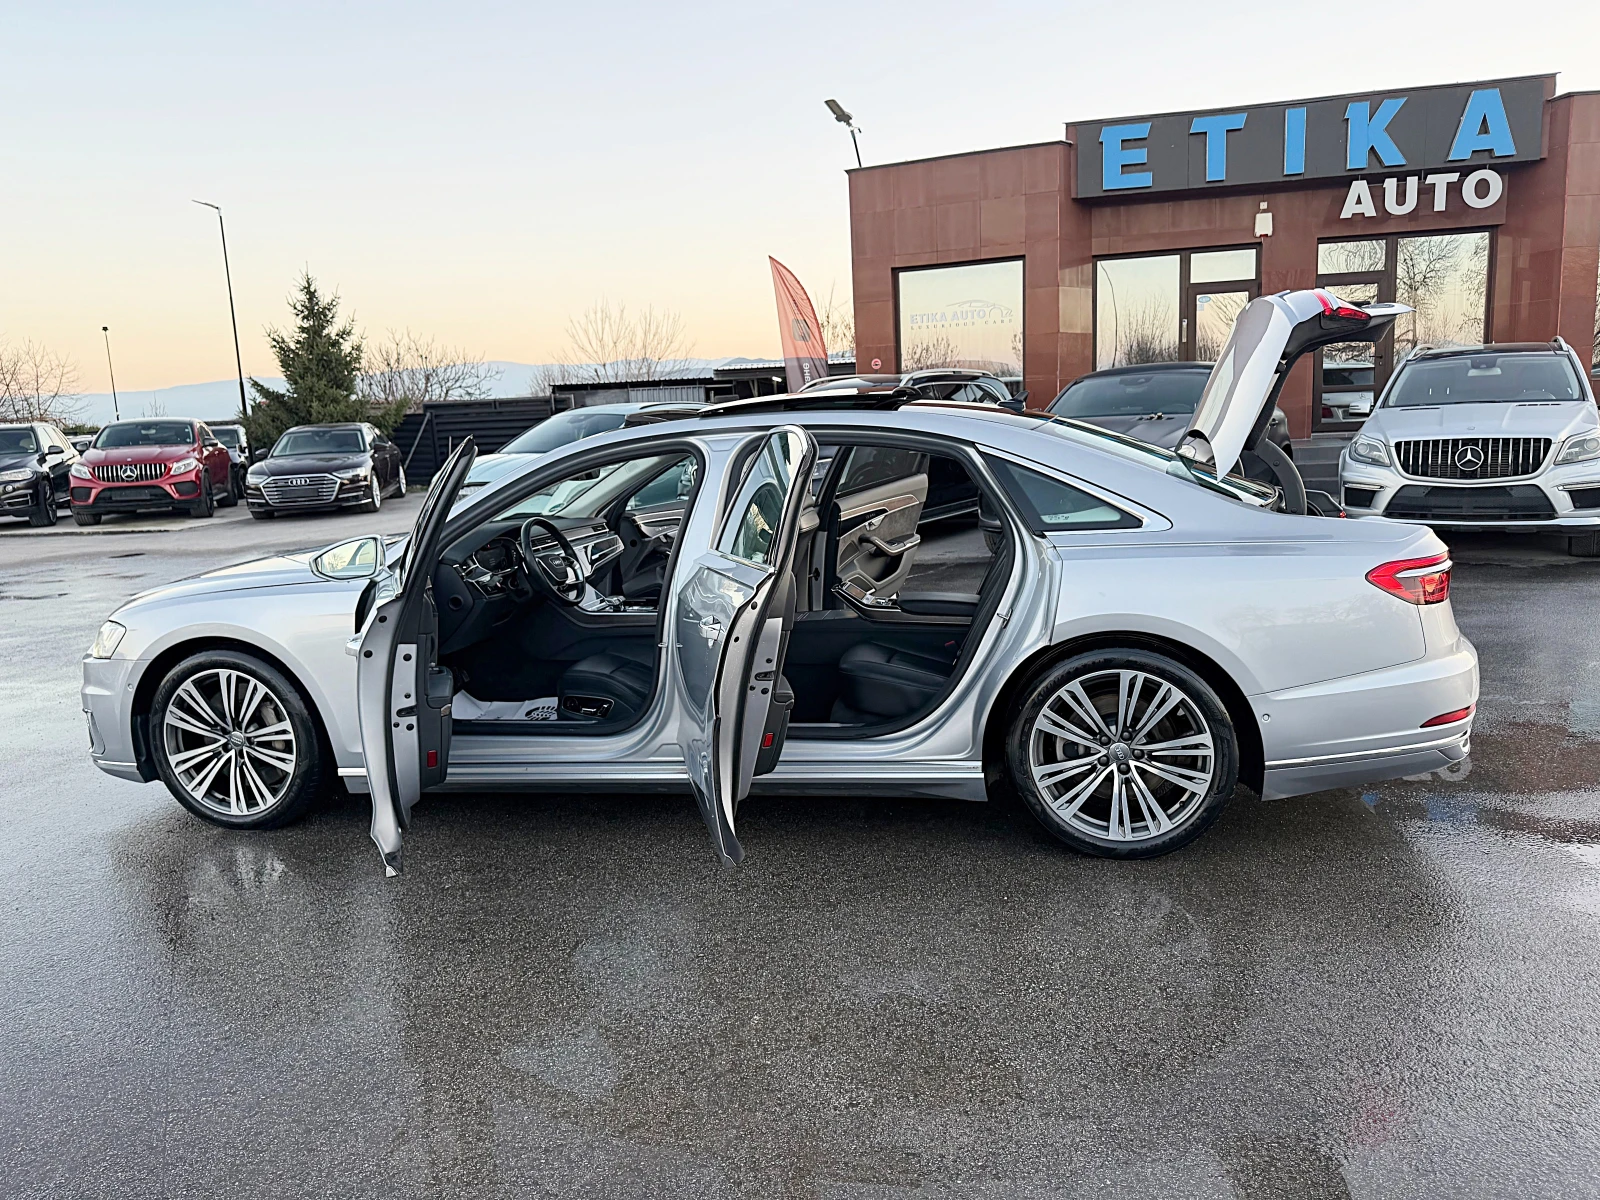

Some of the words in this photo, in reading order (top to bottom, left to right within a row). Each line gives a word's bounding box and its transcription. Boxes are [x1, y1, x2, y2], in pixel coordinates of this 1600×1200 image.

[1099, 87, 1517, 190] ETIKA
[1339, 169, 1503, 219] AUTO
[910, 312, 948, 325] ETIKA
[950, 308, 987, 321] AUTO
